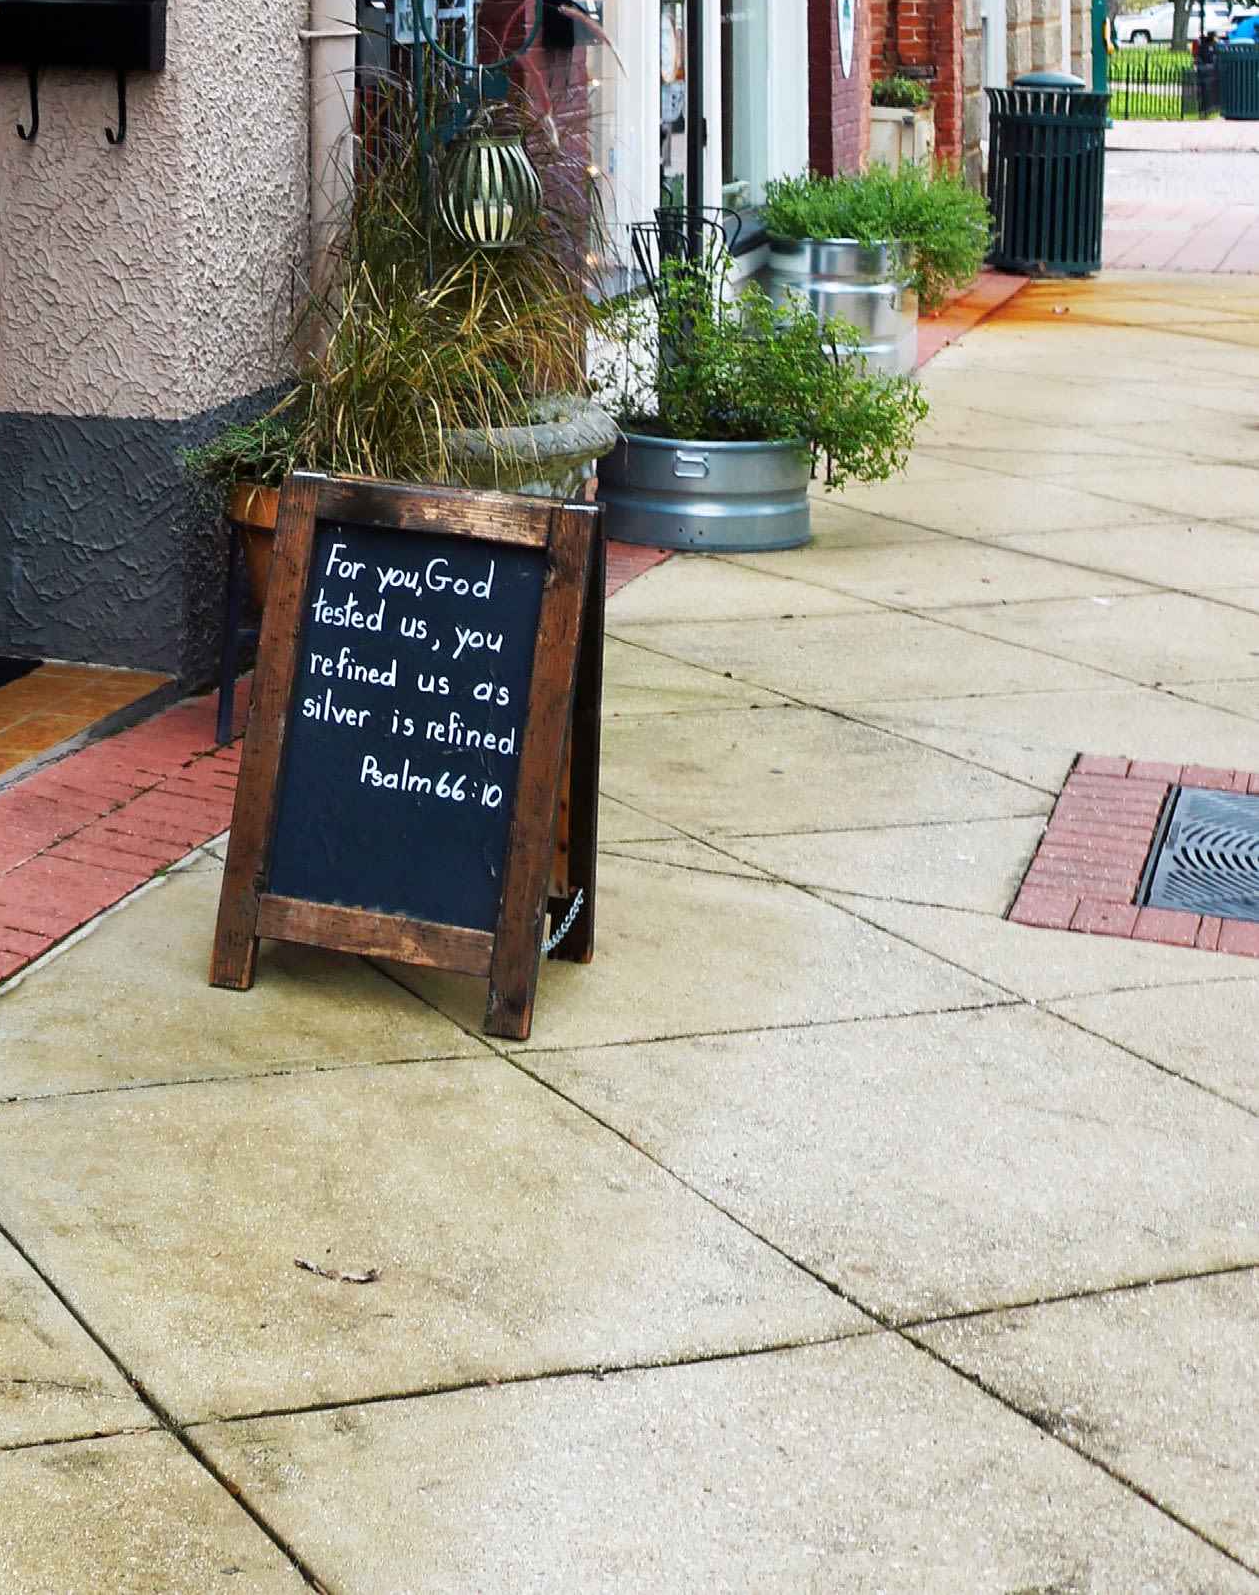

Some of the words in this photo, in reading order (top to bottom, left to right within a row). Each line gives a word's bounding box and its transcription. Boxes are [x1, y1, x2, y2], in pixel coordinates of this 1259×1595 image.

[325, 543, 366, 580] For
[425, 558, 495, 600] God
[311, 587, 386, 632] tested
[400, 617, 440, 651] us,
[452, 626, 503, 660] you
[310, 646, 397, 687] refined
[417, 673, 450, 695] us
[473, 682, 510, 706] as
[302, 688, 371, 728] silver
[391, 709, 415, 737] is
